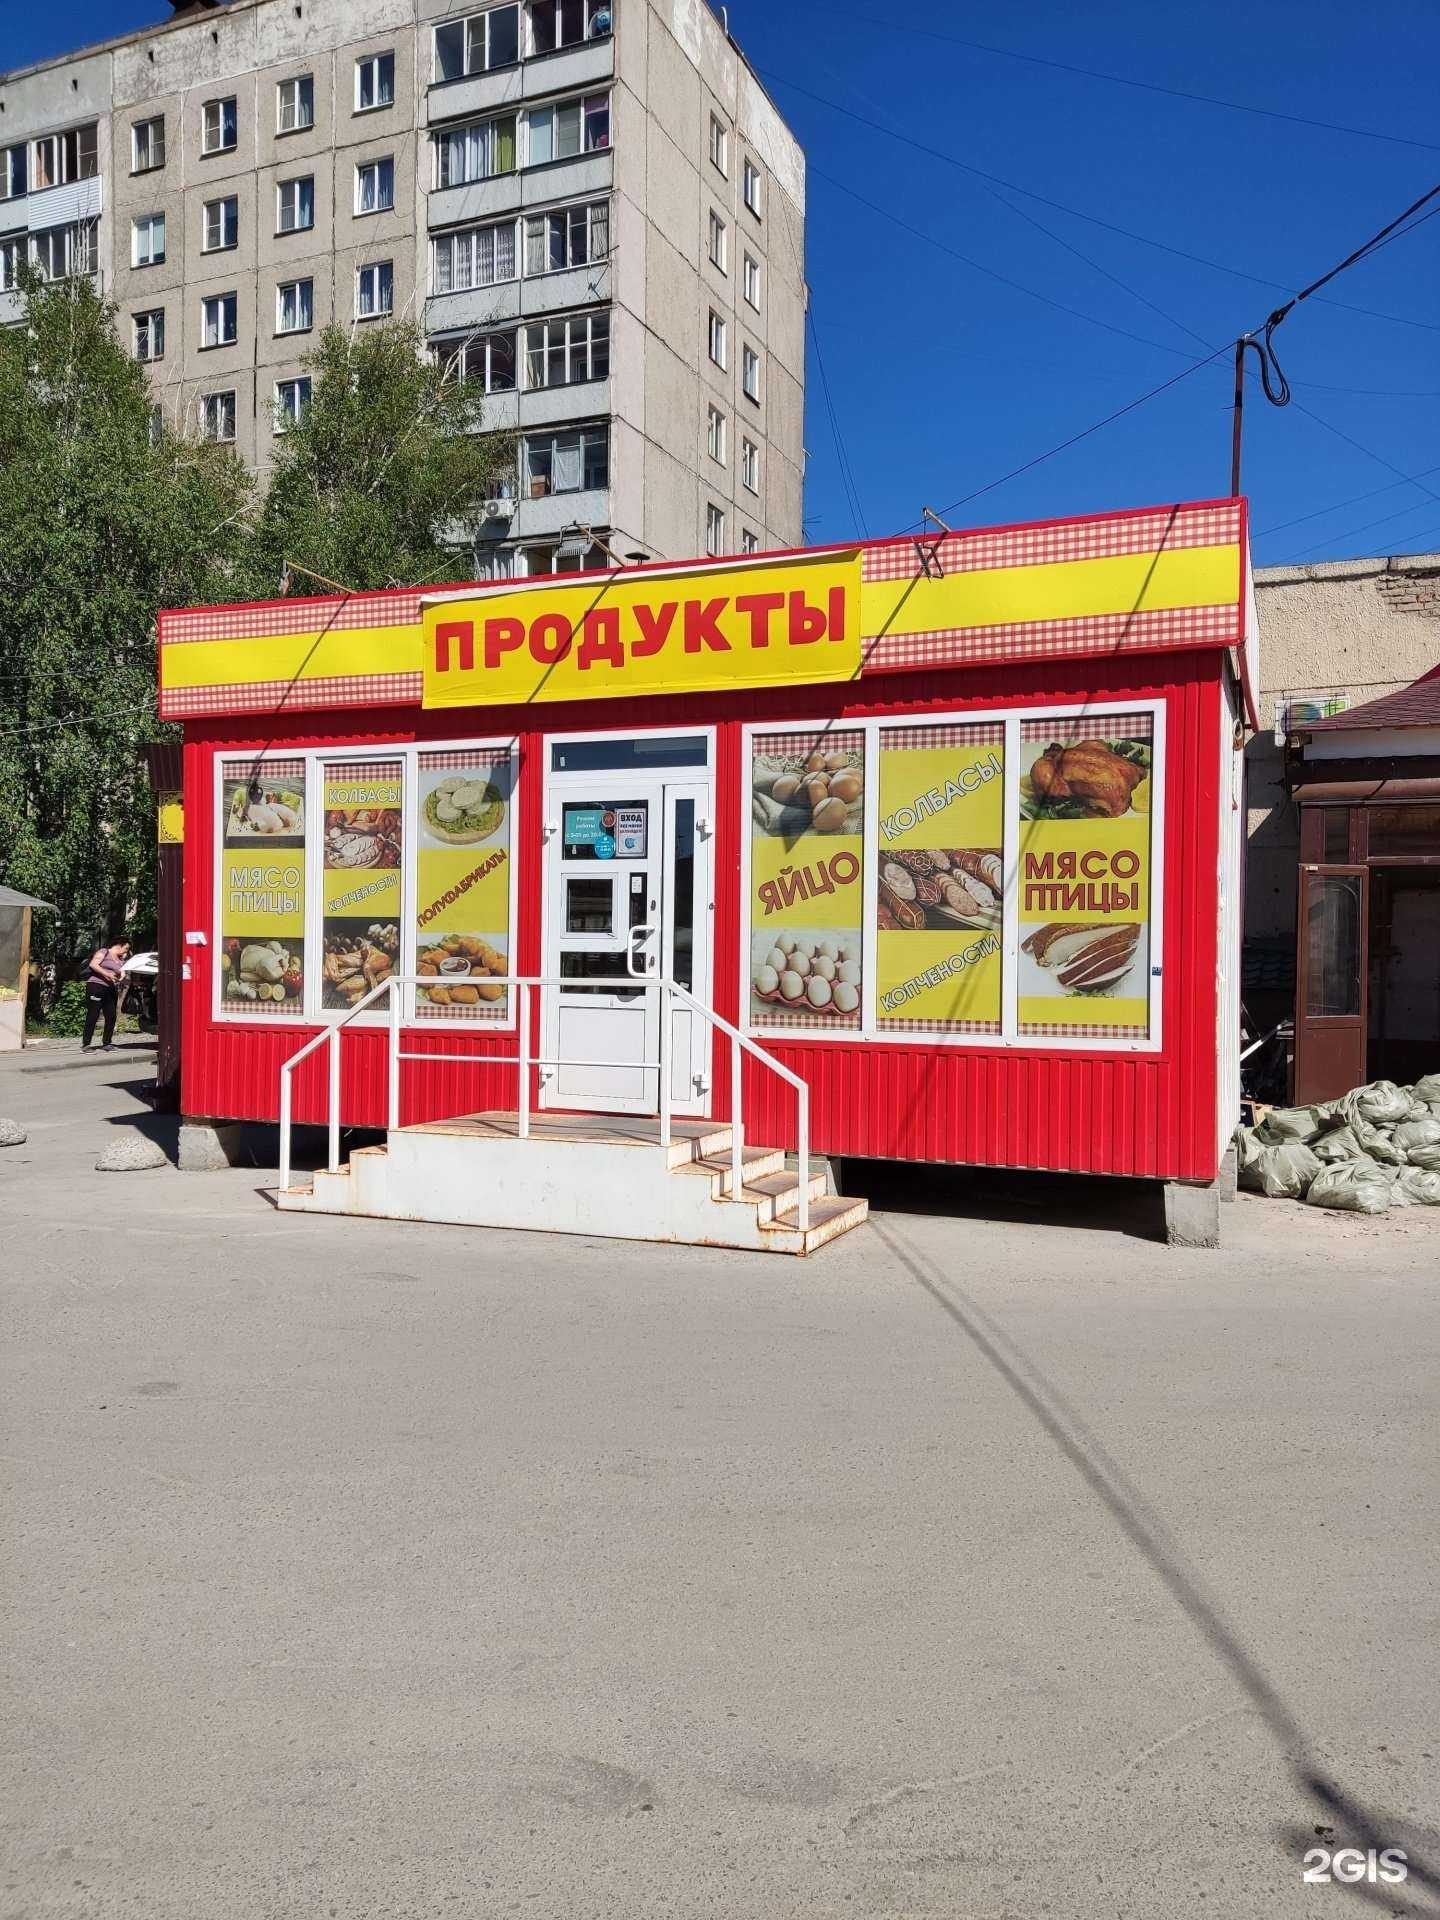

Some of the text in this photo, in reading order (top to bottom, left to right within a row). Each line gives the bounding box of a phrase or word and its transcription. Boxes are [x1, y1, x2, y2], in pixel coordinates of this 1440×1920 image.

[435, 586, 845, 672] ПРОДУКТЫ
[328, 785, 401, 804] КОЛБАСЫ
[880, 753, 1003, 841] КОЛБАСЫ
[620, 814, 643, 823] ВХОД
[229, 866, 301, 888] МЯСО
[1024, 850, 1140, 879] МЯСО
[327, 873, 399, 912] КОПЧЕНОСТИ
[416, 848, 508, 928] ПОЛУФАБРИКАТЫ
[757, 851, 860, 915] ЯЙЦО
[1024, 882, 1139, 914] ПТИЦЫ
[229, 890, 300, 914] ПТИЦЫ
[880, 932, 1001, 1013] КОПЧЕНОСТИ
